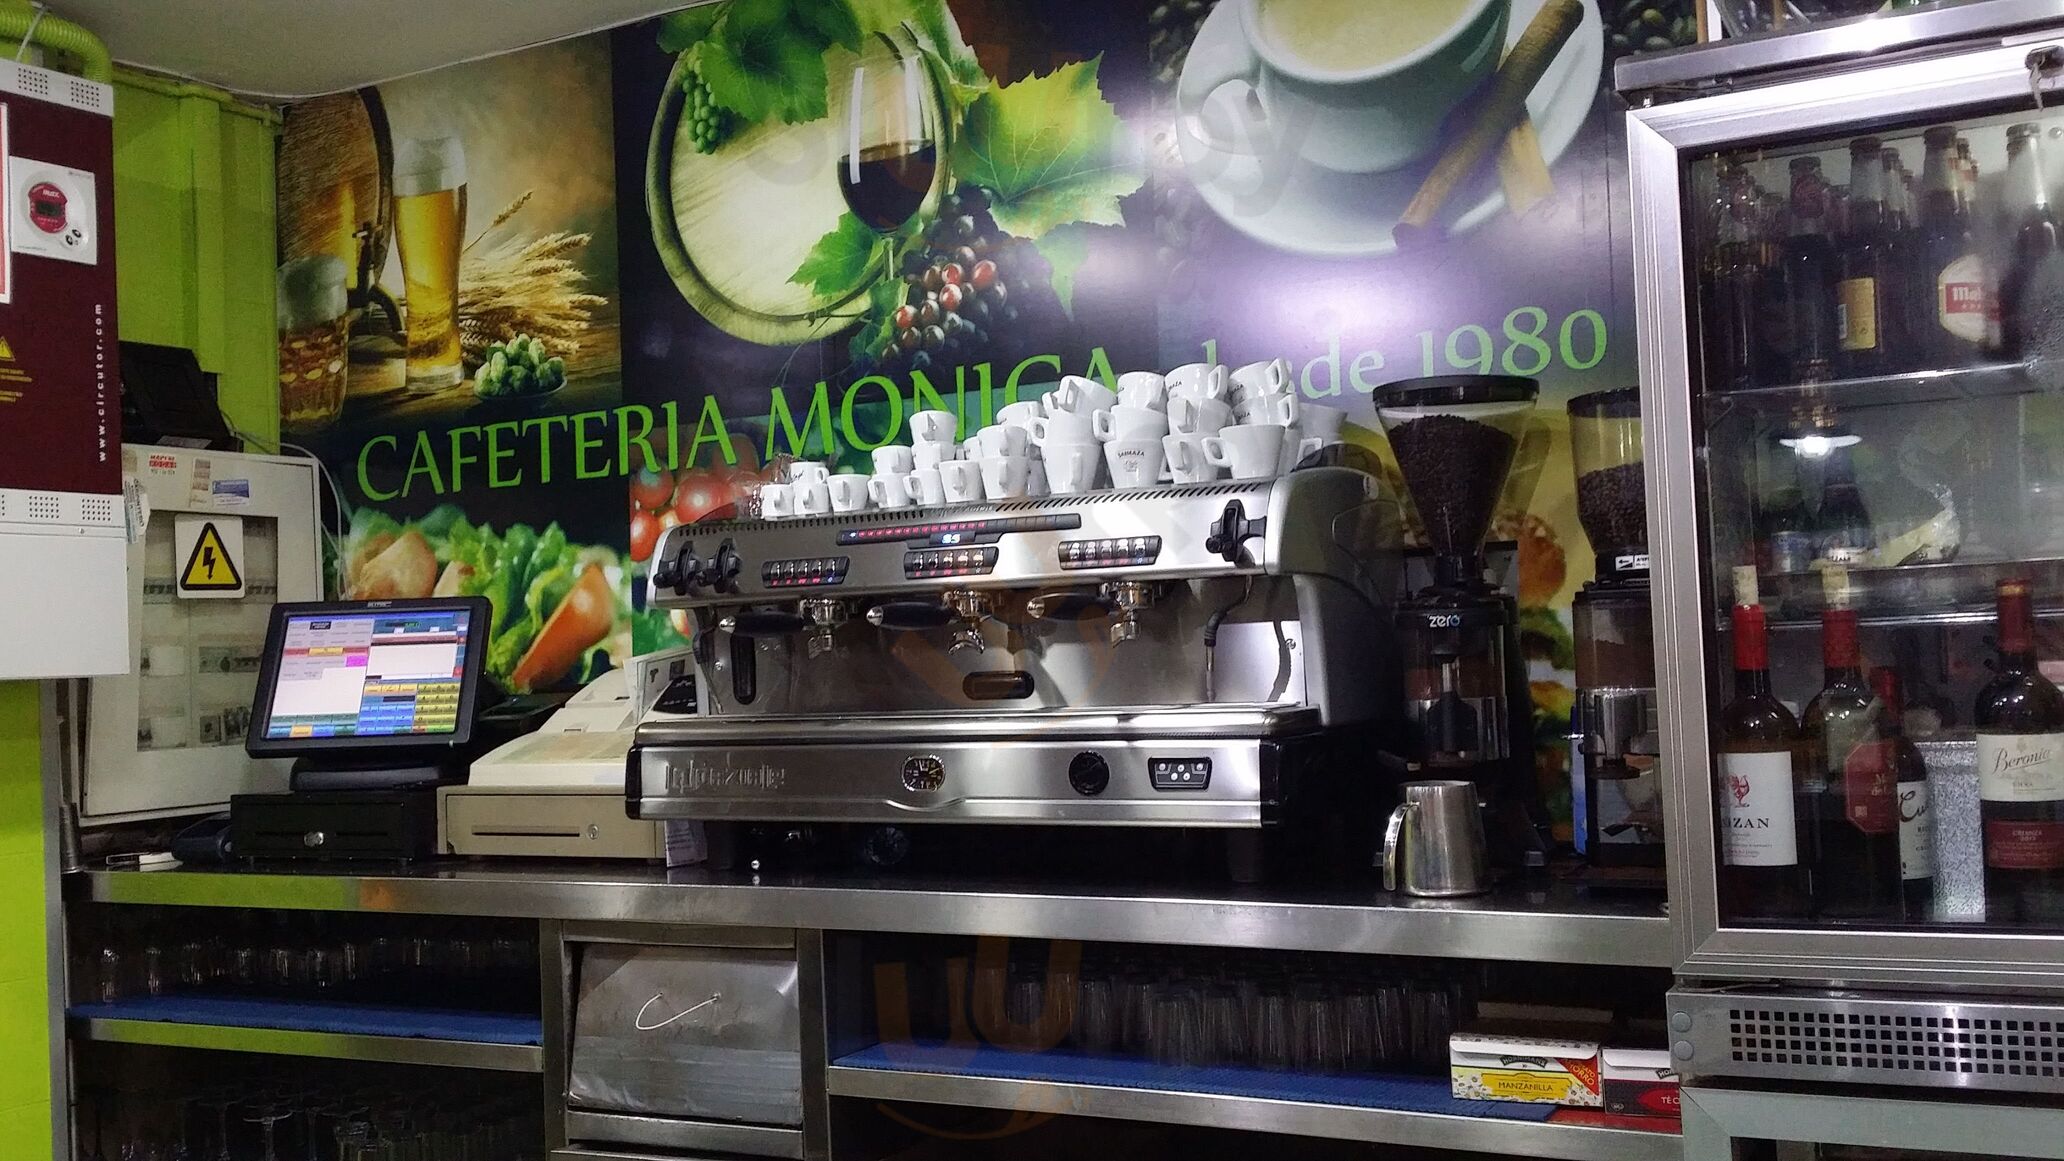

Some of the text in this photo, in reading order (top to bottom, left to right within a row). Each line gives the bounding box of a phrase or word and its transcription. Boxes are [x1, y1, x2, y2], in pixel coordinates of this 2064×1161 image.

[95, 304, 106, 462] www.circutor.com
[357, 395, 738, 501] CAFETERIA
[765, 347, 1119, 461] MONICA
[1415, 306, 1608, 377] 1980
[1429, 614, 1460, 628] zero
[1498, 1082, 1553, 1092] MANZANILLA
